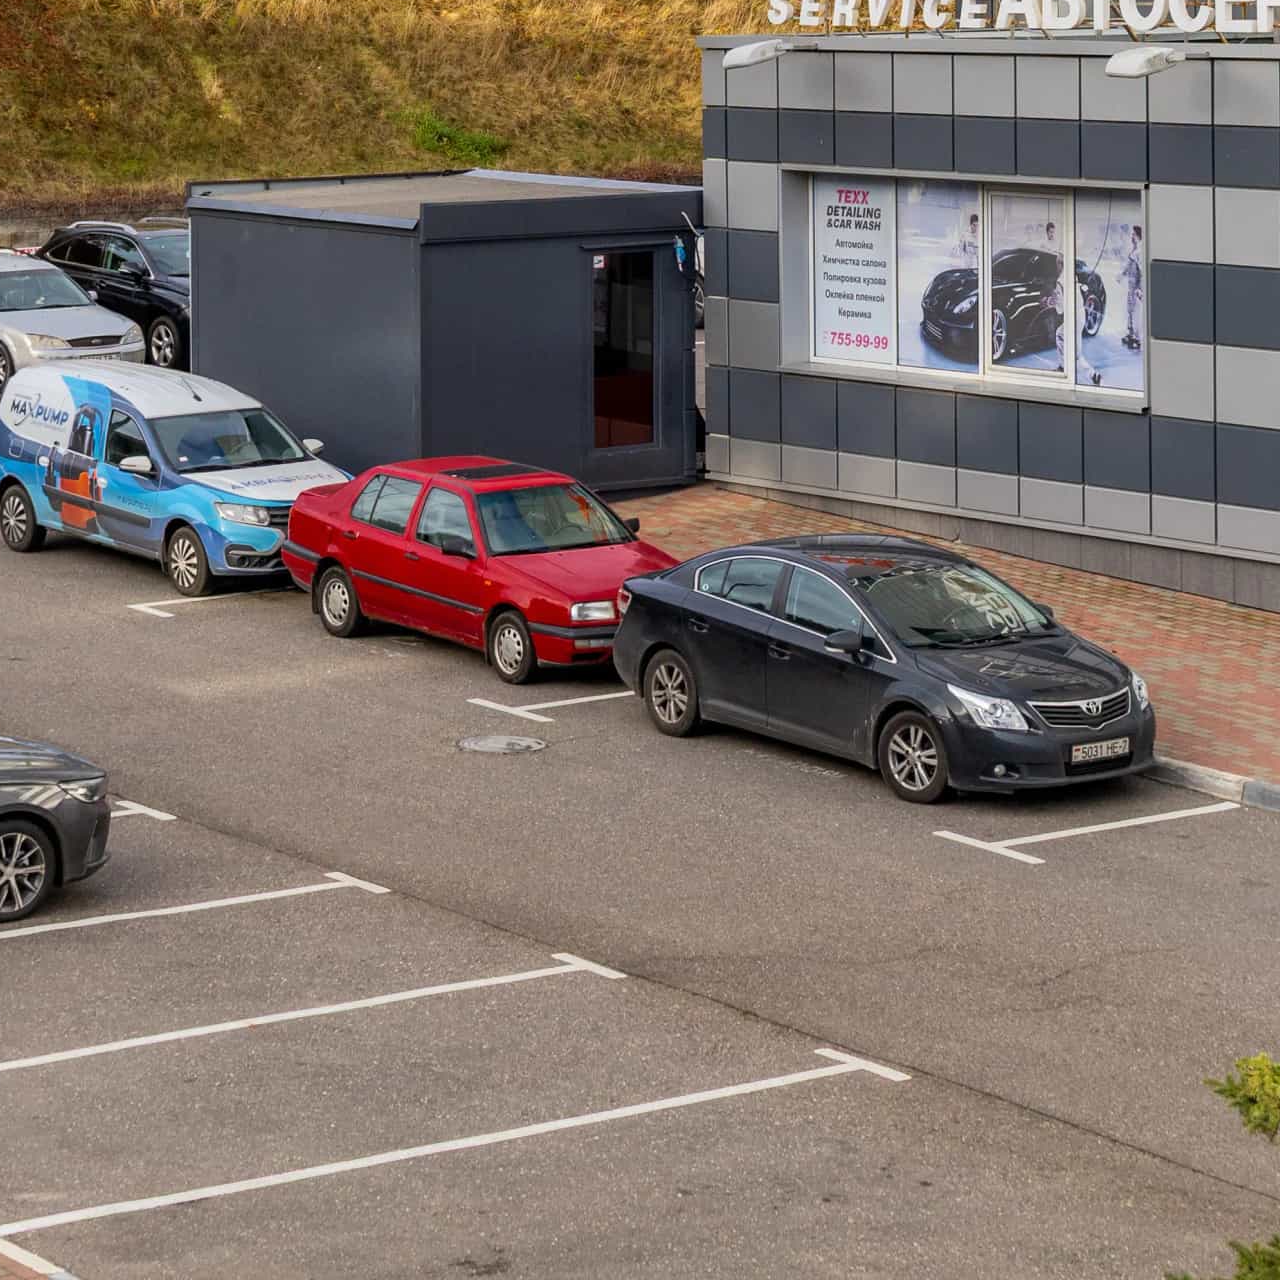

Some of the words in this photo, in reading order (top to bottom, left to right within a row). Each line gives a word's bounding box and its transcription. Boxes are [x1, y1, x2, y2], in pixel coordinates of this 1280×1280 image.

[836, 189, 870, 205] TEXX
[826, 206, 882, 220] DETAILING
[854, 220, 881, 232] WASH
[834, 238, 874, 250] Автомойка
[822, 255, 860, 267] Химчистка
[861, 259, 887, 269] салона
[823, 271, 862, 284] Полировка
[862, 276, 887, 287] кузова
[825, 288, 854, 300] Оклейка
[855, 292, 885, 303] пленкой
[838, 306, 872, 319] Керамика
[830, 331, 889, 350] 755-99-99
[10, 394, 70, 426] MAXPUMP
[1081, 745, 1104, 759] 5031
